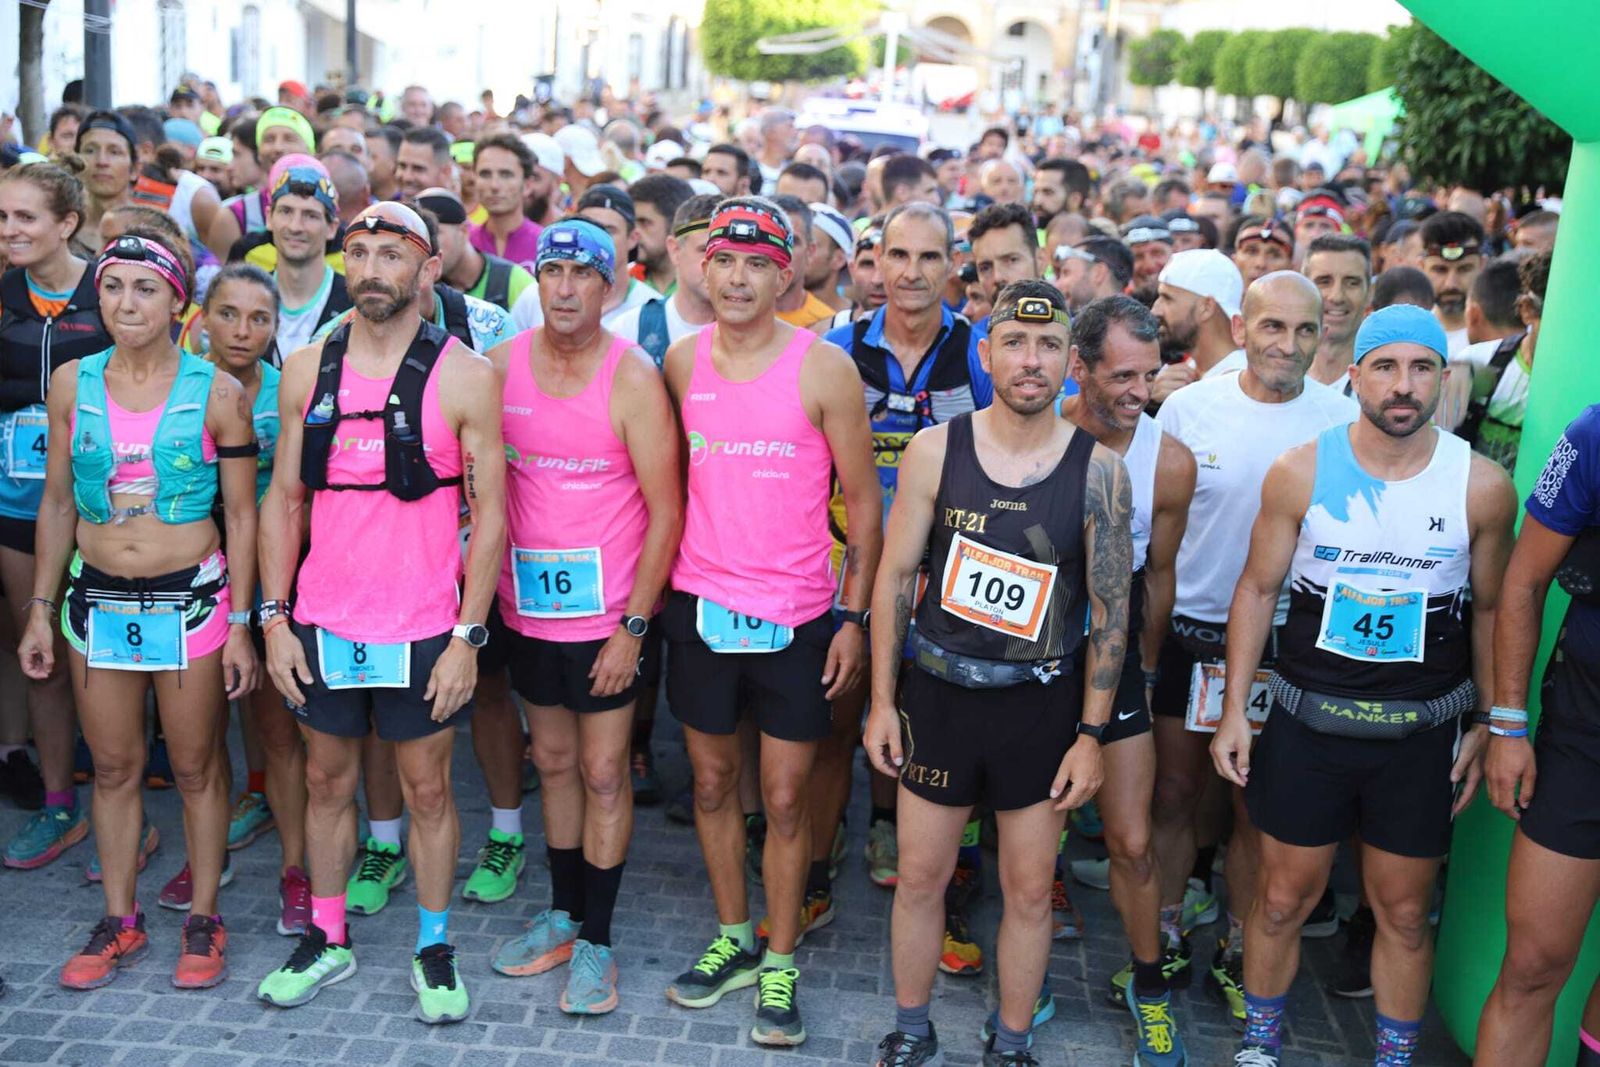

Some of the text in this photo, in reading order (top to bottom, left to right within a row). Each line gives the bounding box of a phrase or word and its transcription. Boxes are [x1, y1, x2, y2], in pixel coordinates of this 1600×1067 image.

[990, 499, 1028, 511] Joma
[943, 507, 988, 533] RT-21
[963, 546, 1012, 572] ALFAJOR
[538, 570, 572, 595] 16
[968, 571, 1026, 611] 109
[974, 600, 1004, 615] PLATON
[126, 622, 143, 647] 8
[1353, 612, 1395, 641] 45
[353, 641, 367, 665] 8
[1321, 702, 1418, 724] HANKER
[908, 762, 949, 788] RT-21
